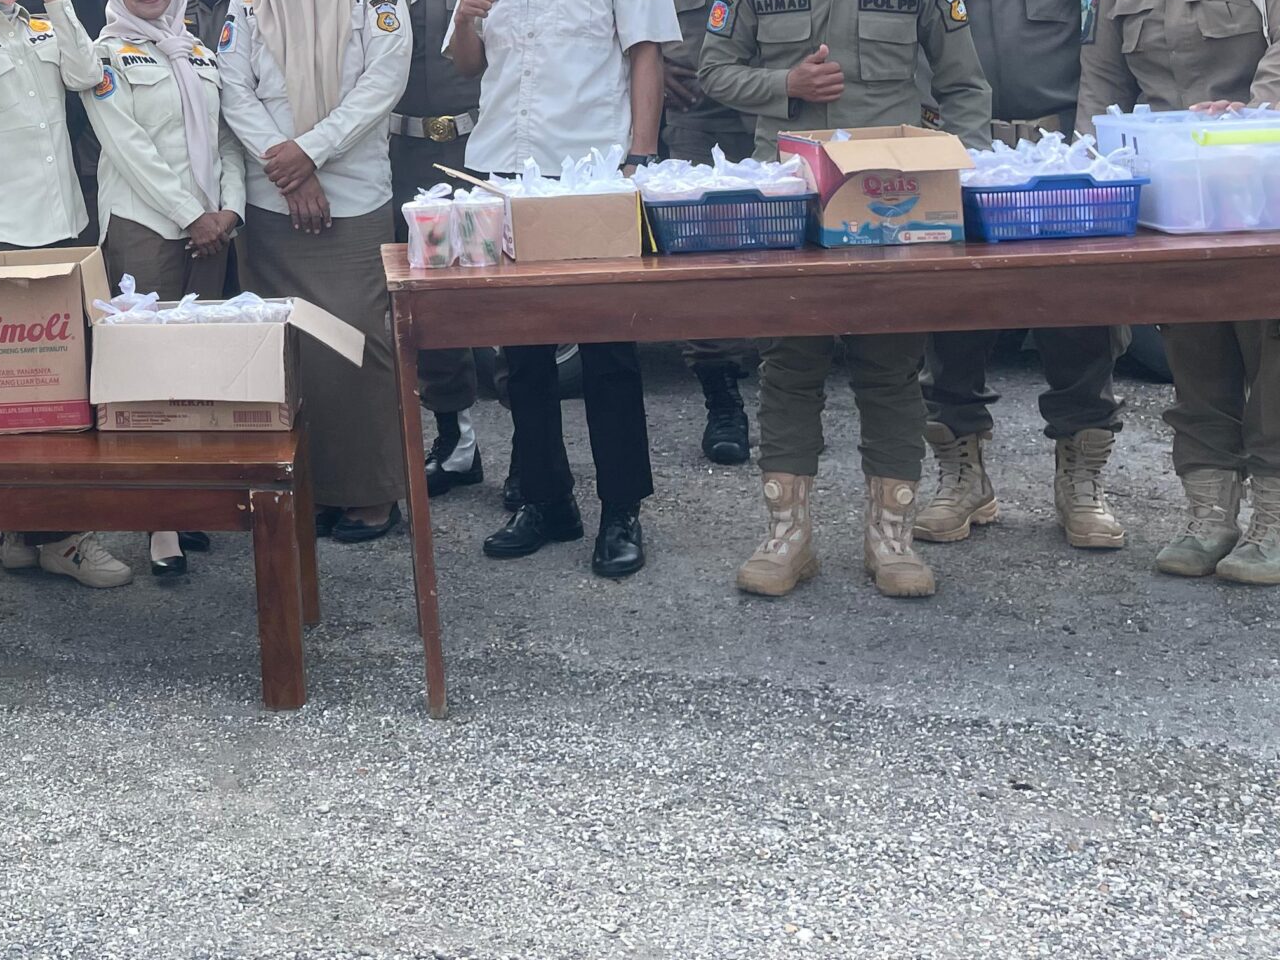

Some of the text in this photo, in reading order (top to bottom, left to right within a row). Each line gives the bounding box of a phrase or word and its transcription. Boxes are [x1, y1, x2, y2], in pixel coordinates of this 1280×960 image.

[29, 33, 54, 44] POL
[863, 175, 919, 196] Qais
[35, 377, 60, 385] DALAM
